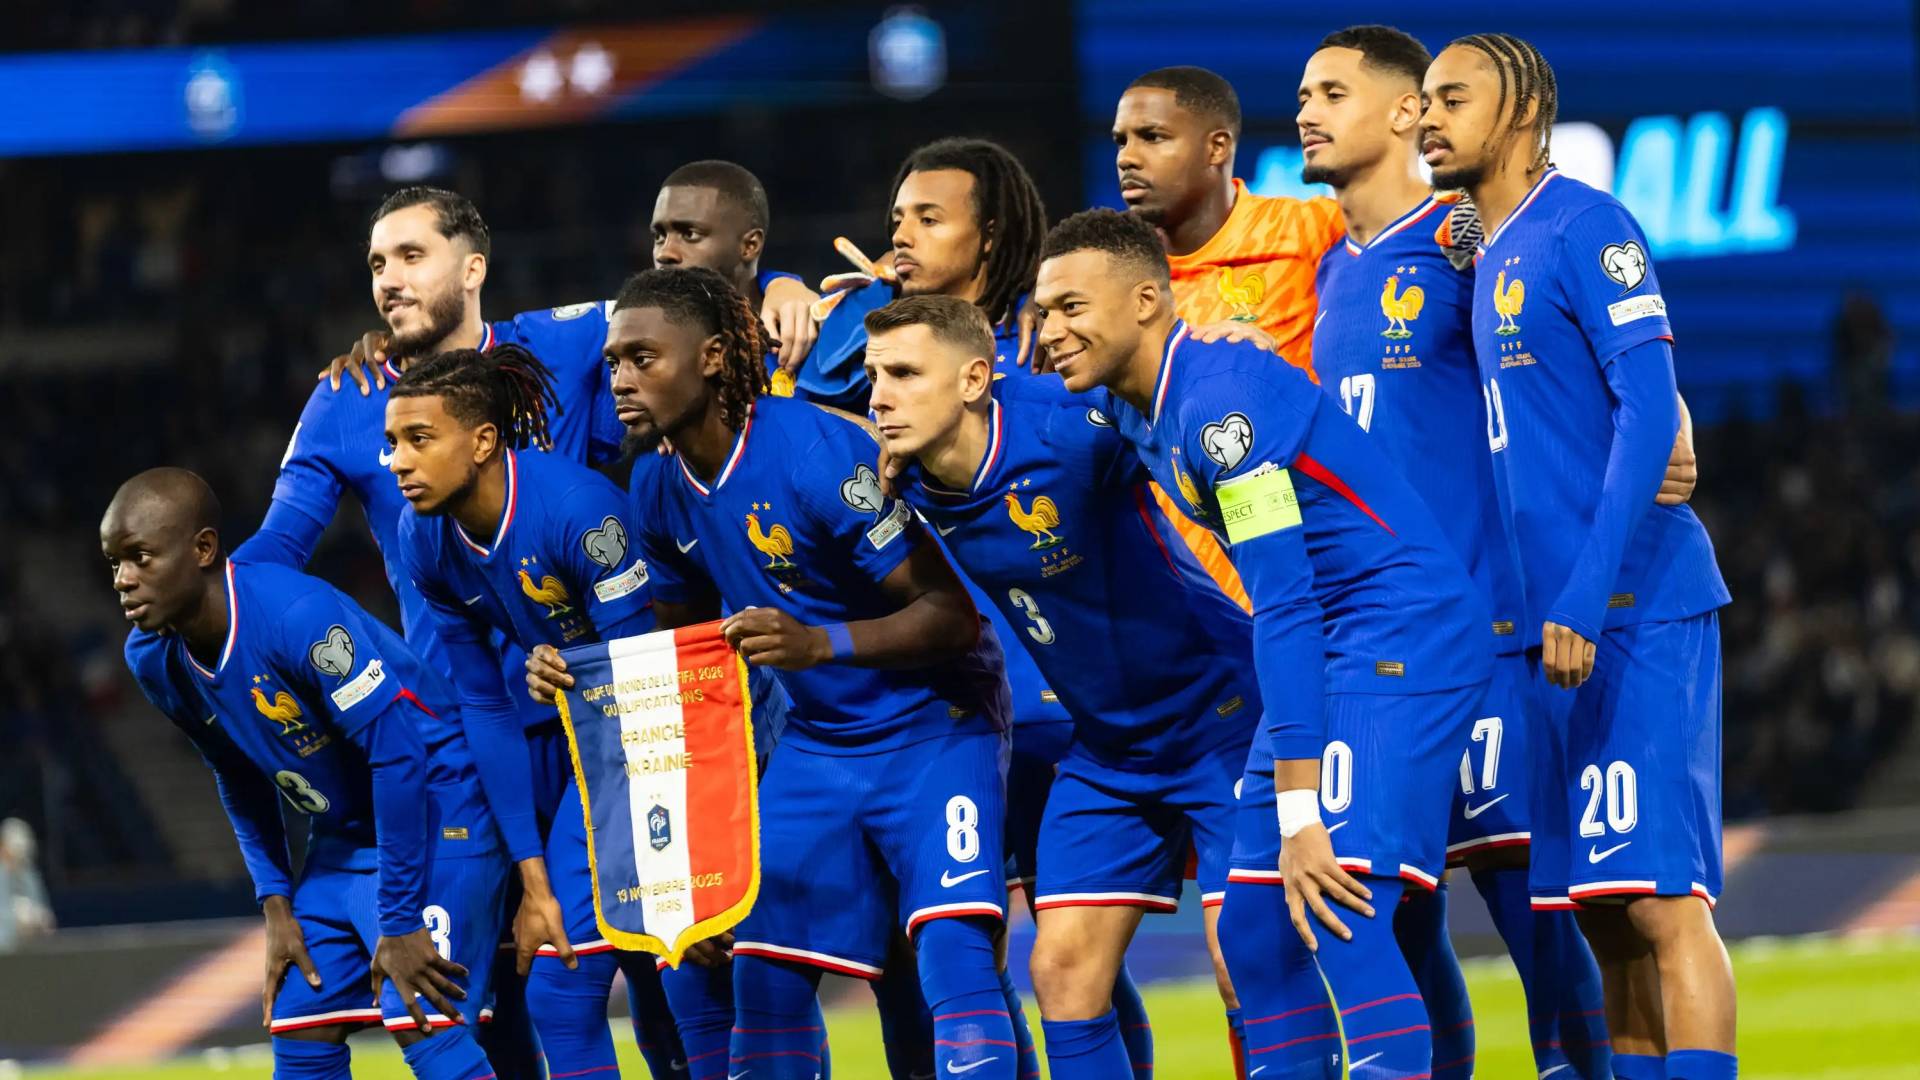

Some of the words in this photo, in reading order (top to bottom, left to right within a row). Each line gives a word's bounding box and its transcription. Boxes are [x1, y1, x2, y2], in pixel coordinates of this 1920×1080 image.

[1009, 587, 1055, 645] 3
[648, 675, 660, 689] DE
[662, 673, 673, 687] LA
[677, 669, 697, 685] FIFA
[698, 666, 724, 681] 2026
[603, 688, 704, 717] QUALIFICATIONS
[622, 721, 688, 746] FRANCE
[623, 752, 694, 778] UKRAINE
[1580, 760, 1638, 838] 20
[945, 794, 980, 863] 8
[690, 872, 724, 889] 2025
[656, 898, 682, 913] PARIS
